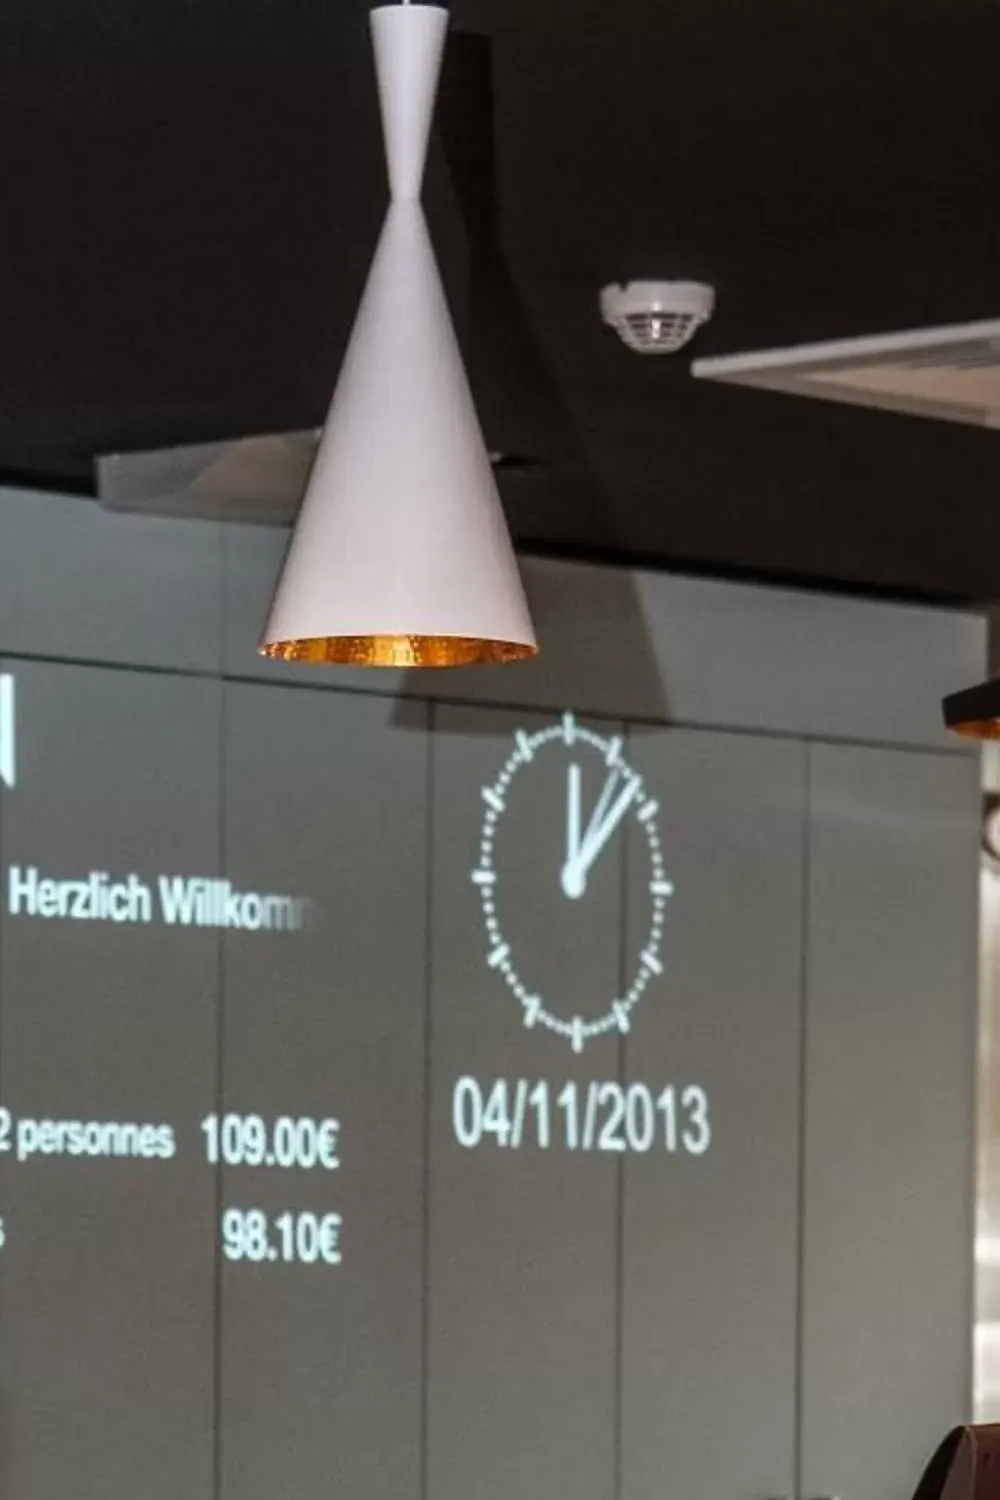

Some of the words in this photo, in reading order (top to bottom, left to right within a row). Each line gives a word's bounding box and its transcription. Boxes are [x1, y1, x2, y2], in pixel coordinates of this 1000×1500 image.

[8, 865, 153, 923] Herzlich
[16, 1117, 177, 1162] personnes
[200, 1113, 341, 1170] 109.00€
[452, 1075, 712, 1156] 04/11/2013
[222, 1207, 342, 1265] 98.10€
